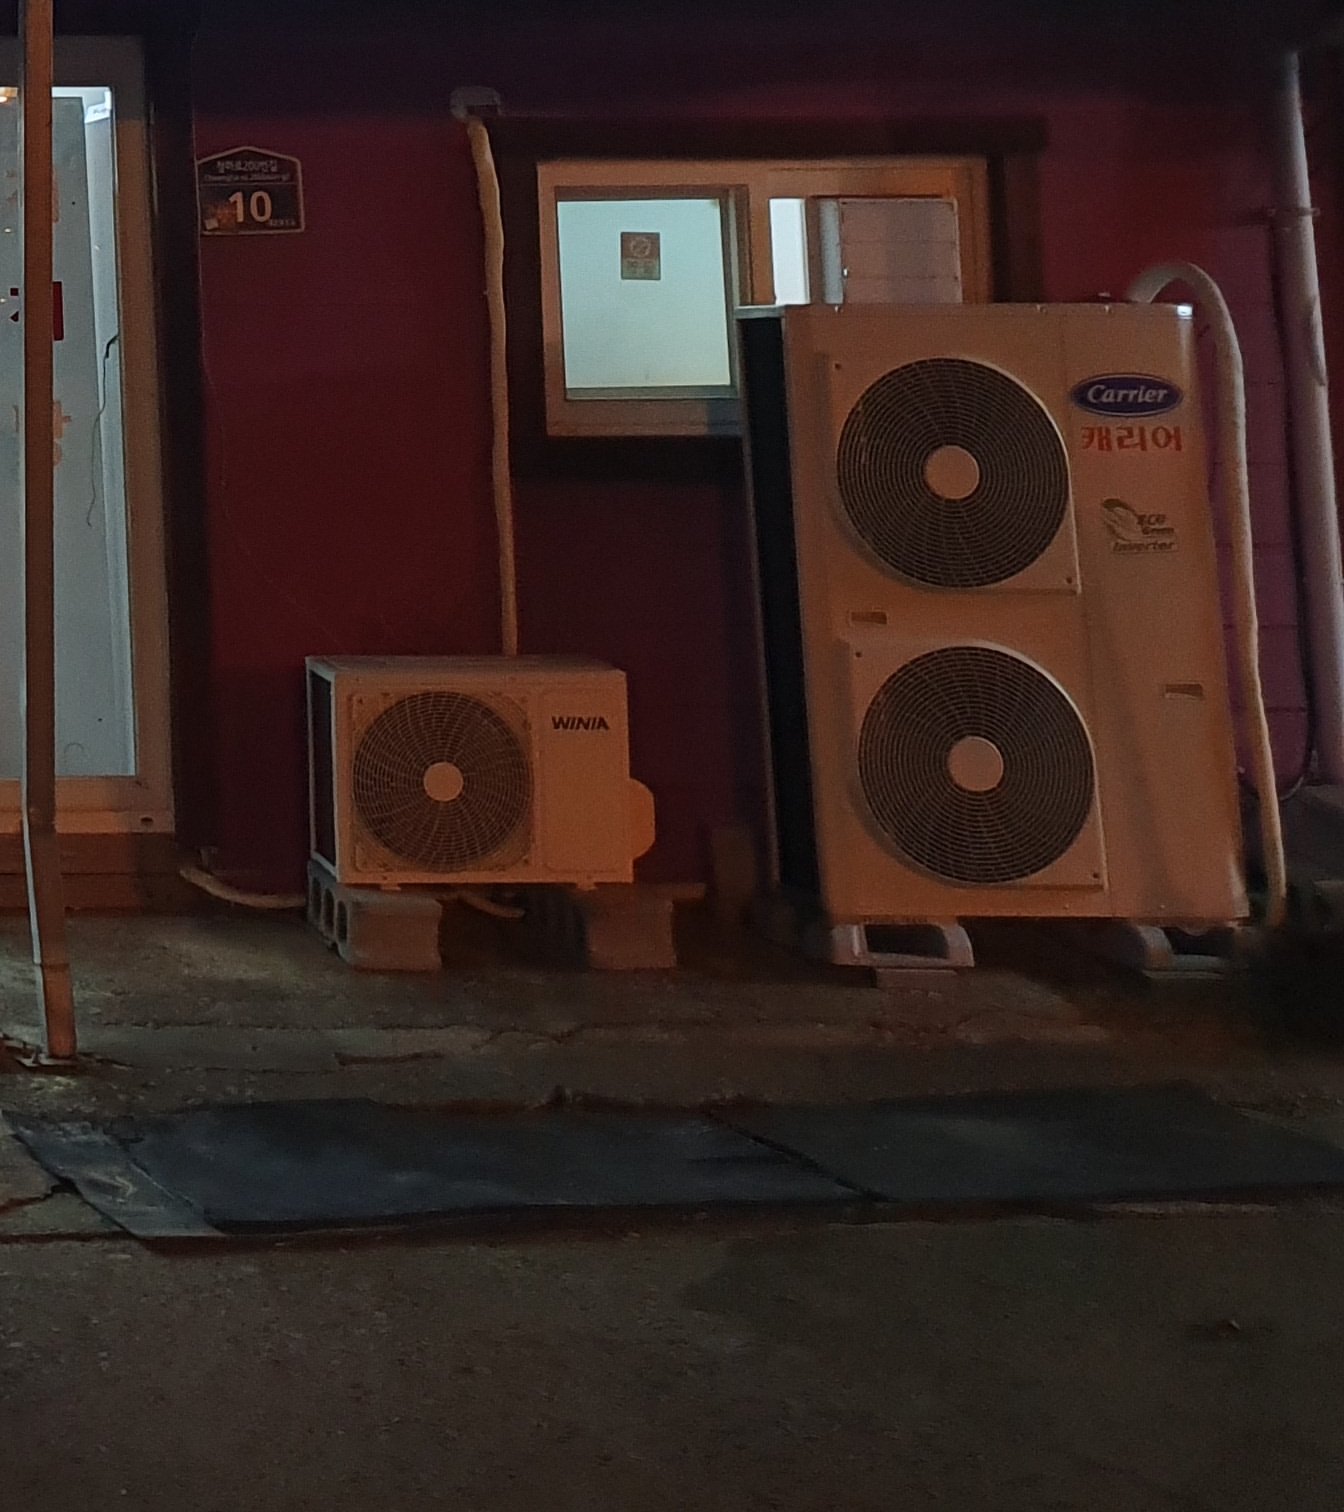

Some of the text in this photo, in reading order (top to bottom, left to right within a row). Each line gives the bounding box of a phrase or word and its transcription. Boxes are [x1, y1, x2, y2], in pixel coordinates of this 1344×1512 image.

[229, 191, 272, 222] 10
[1087, 384, 1168, 404] Carrier
[1082, 425, 1183, 452] 캐리어
[551, 716, 610, 731] WINIA
